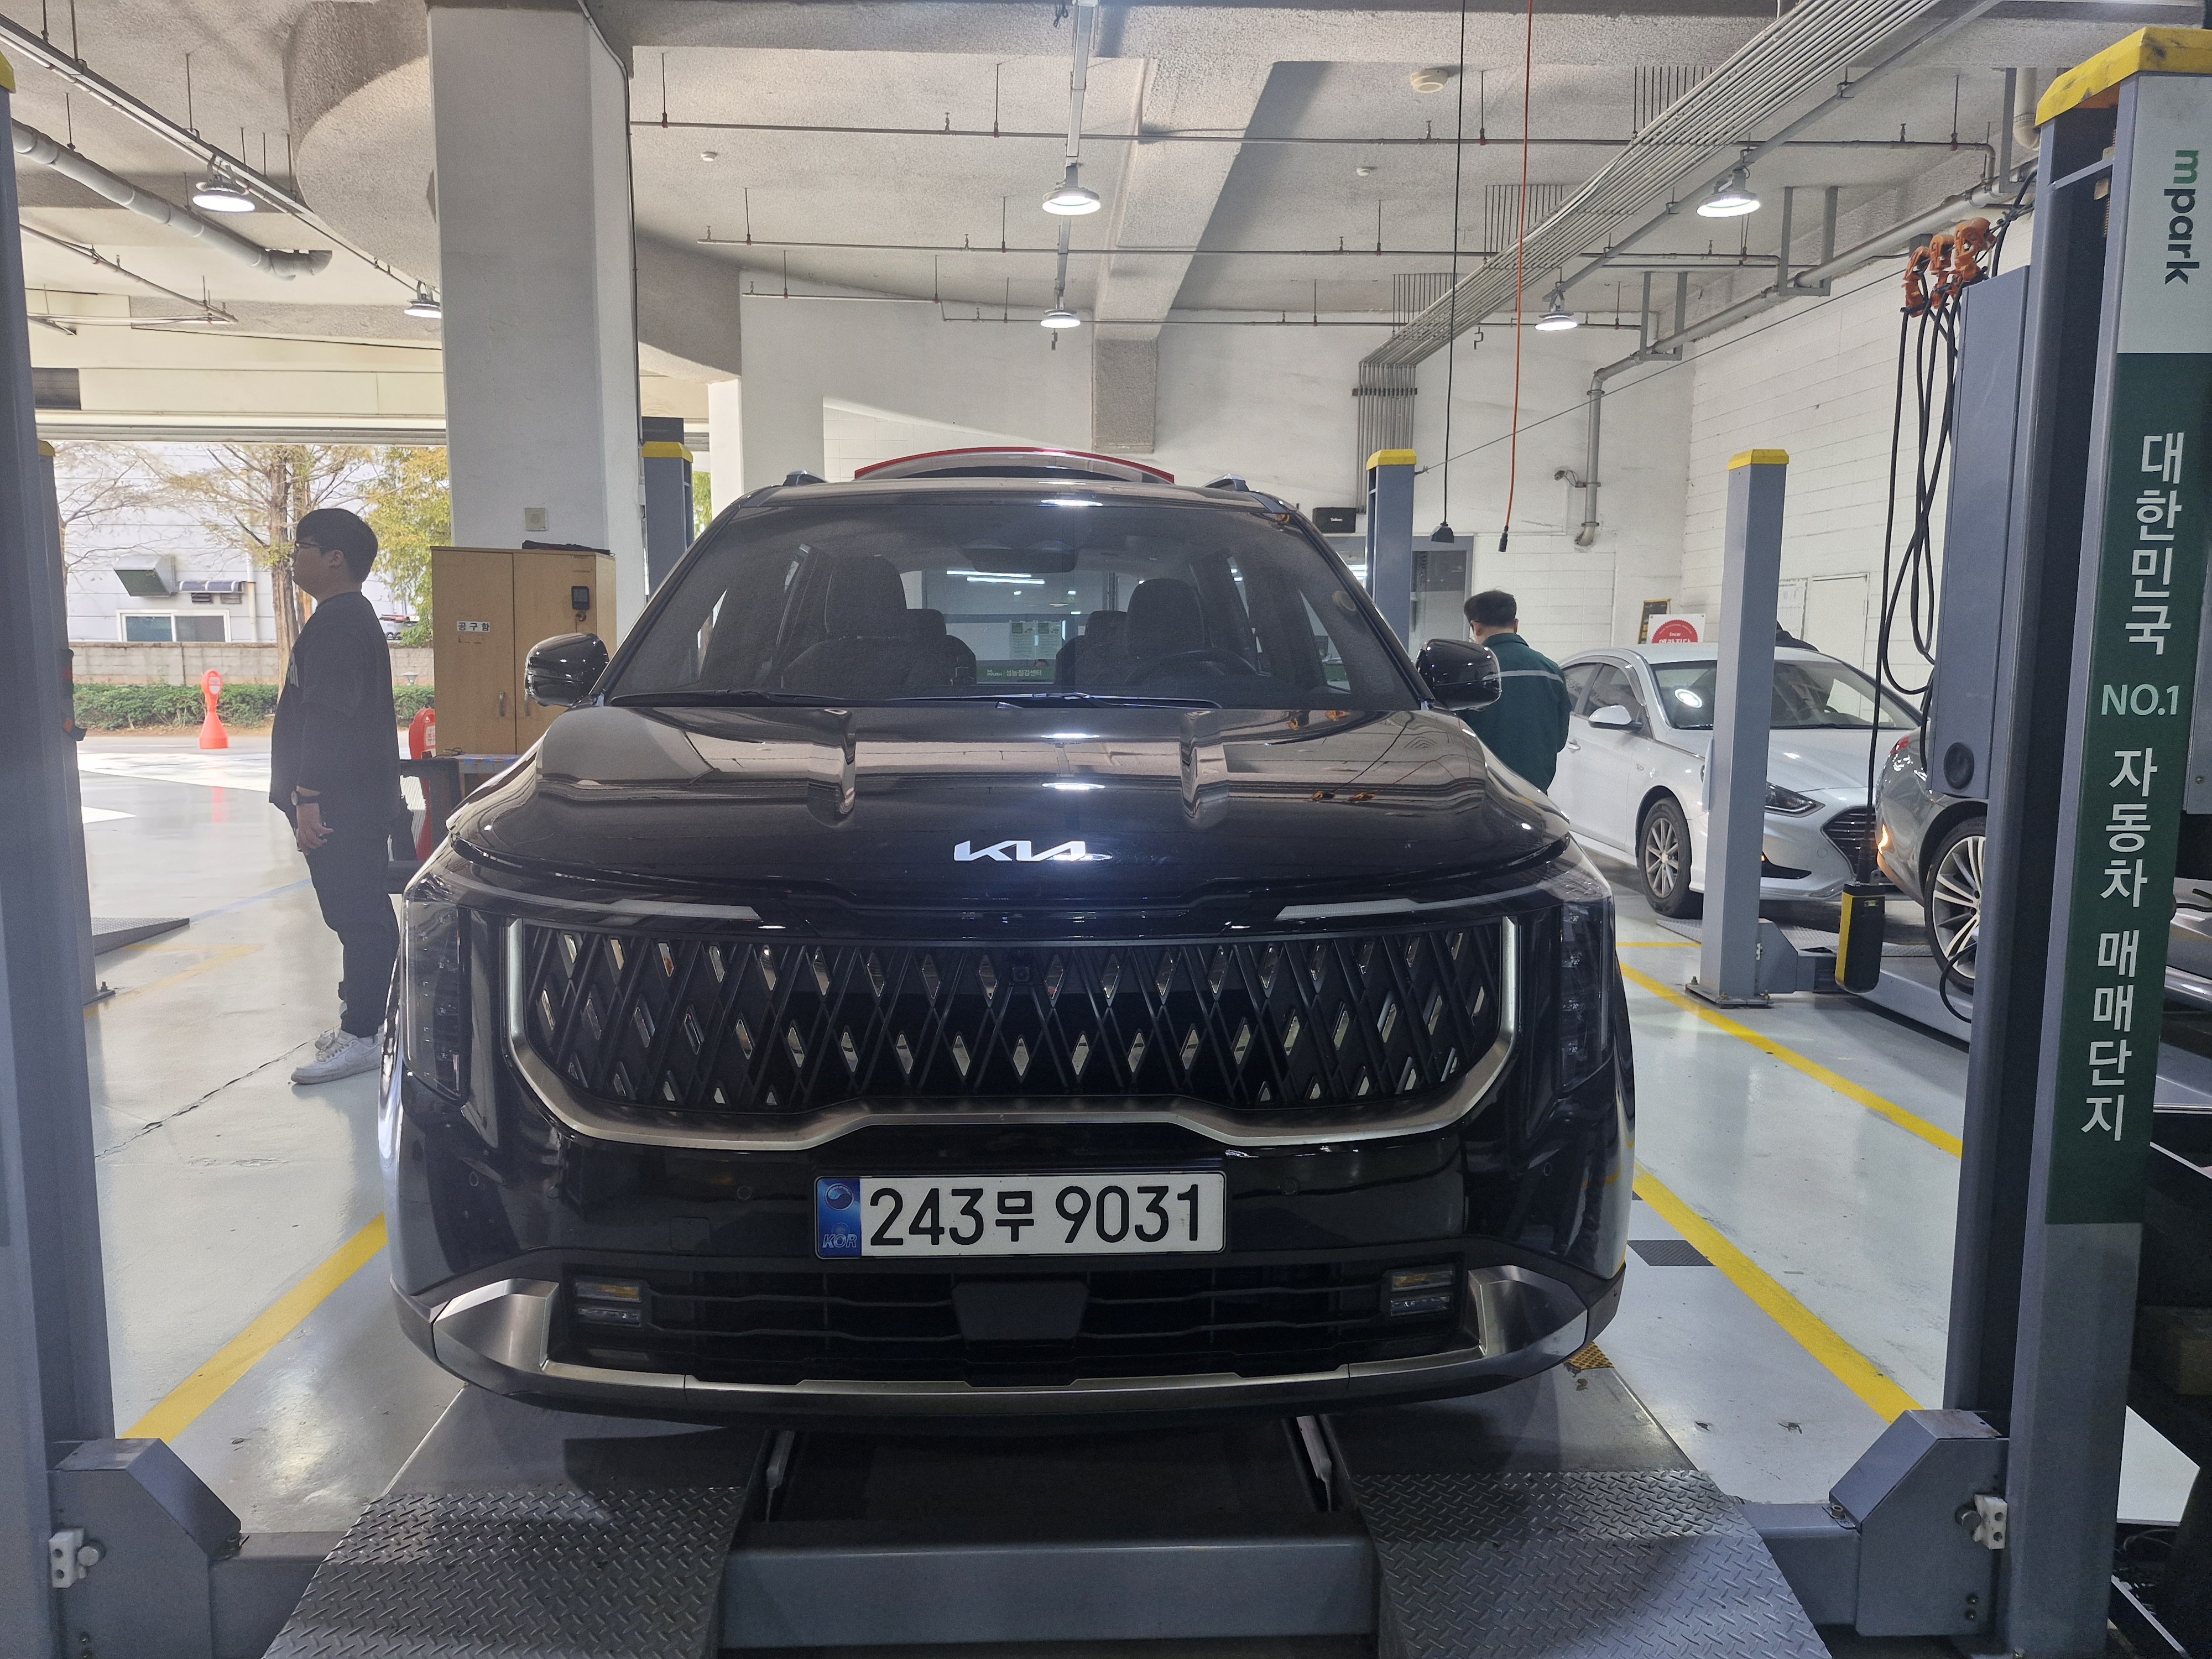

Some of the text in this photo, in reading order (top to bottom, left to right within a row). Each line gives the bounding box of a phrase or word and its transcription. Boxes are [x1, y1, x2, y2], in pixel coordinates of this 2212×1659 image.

[2163, 150, 2200, 285] mpark
[2080, 432, 2184, 1141] 대한민국 NO.1 자동차 매매단지
[954, 840, 1086, 861] KIA
[822, 1234, 857, 1248] KOR
[870, 1184, 1198, 1246] 243무 9031
